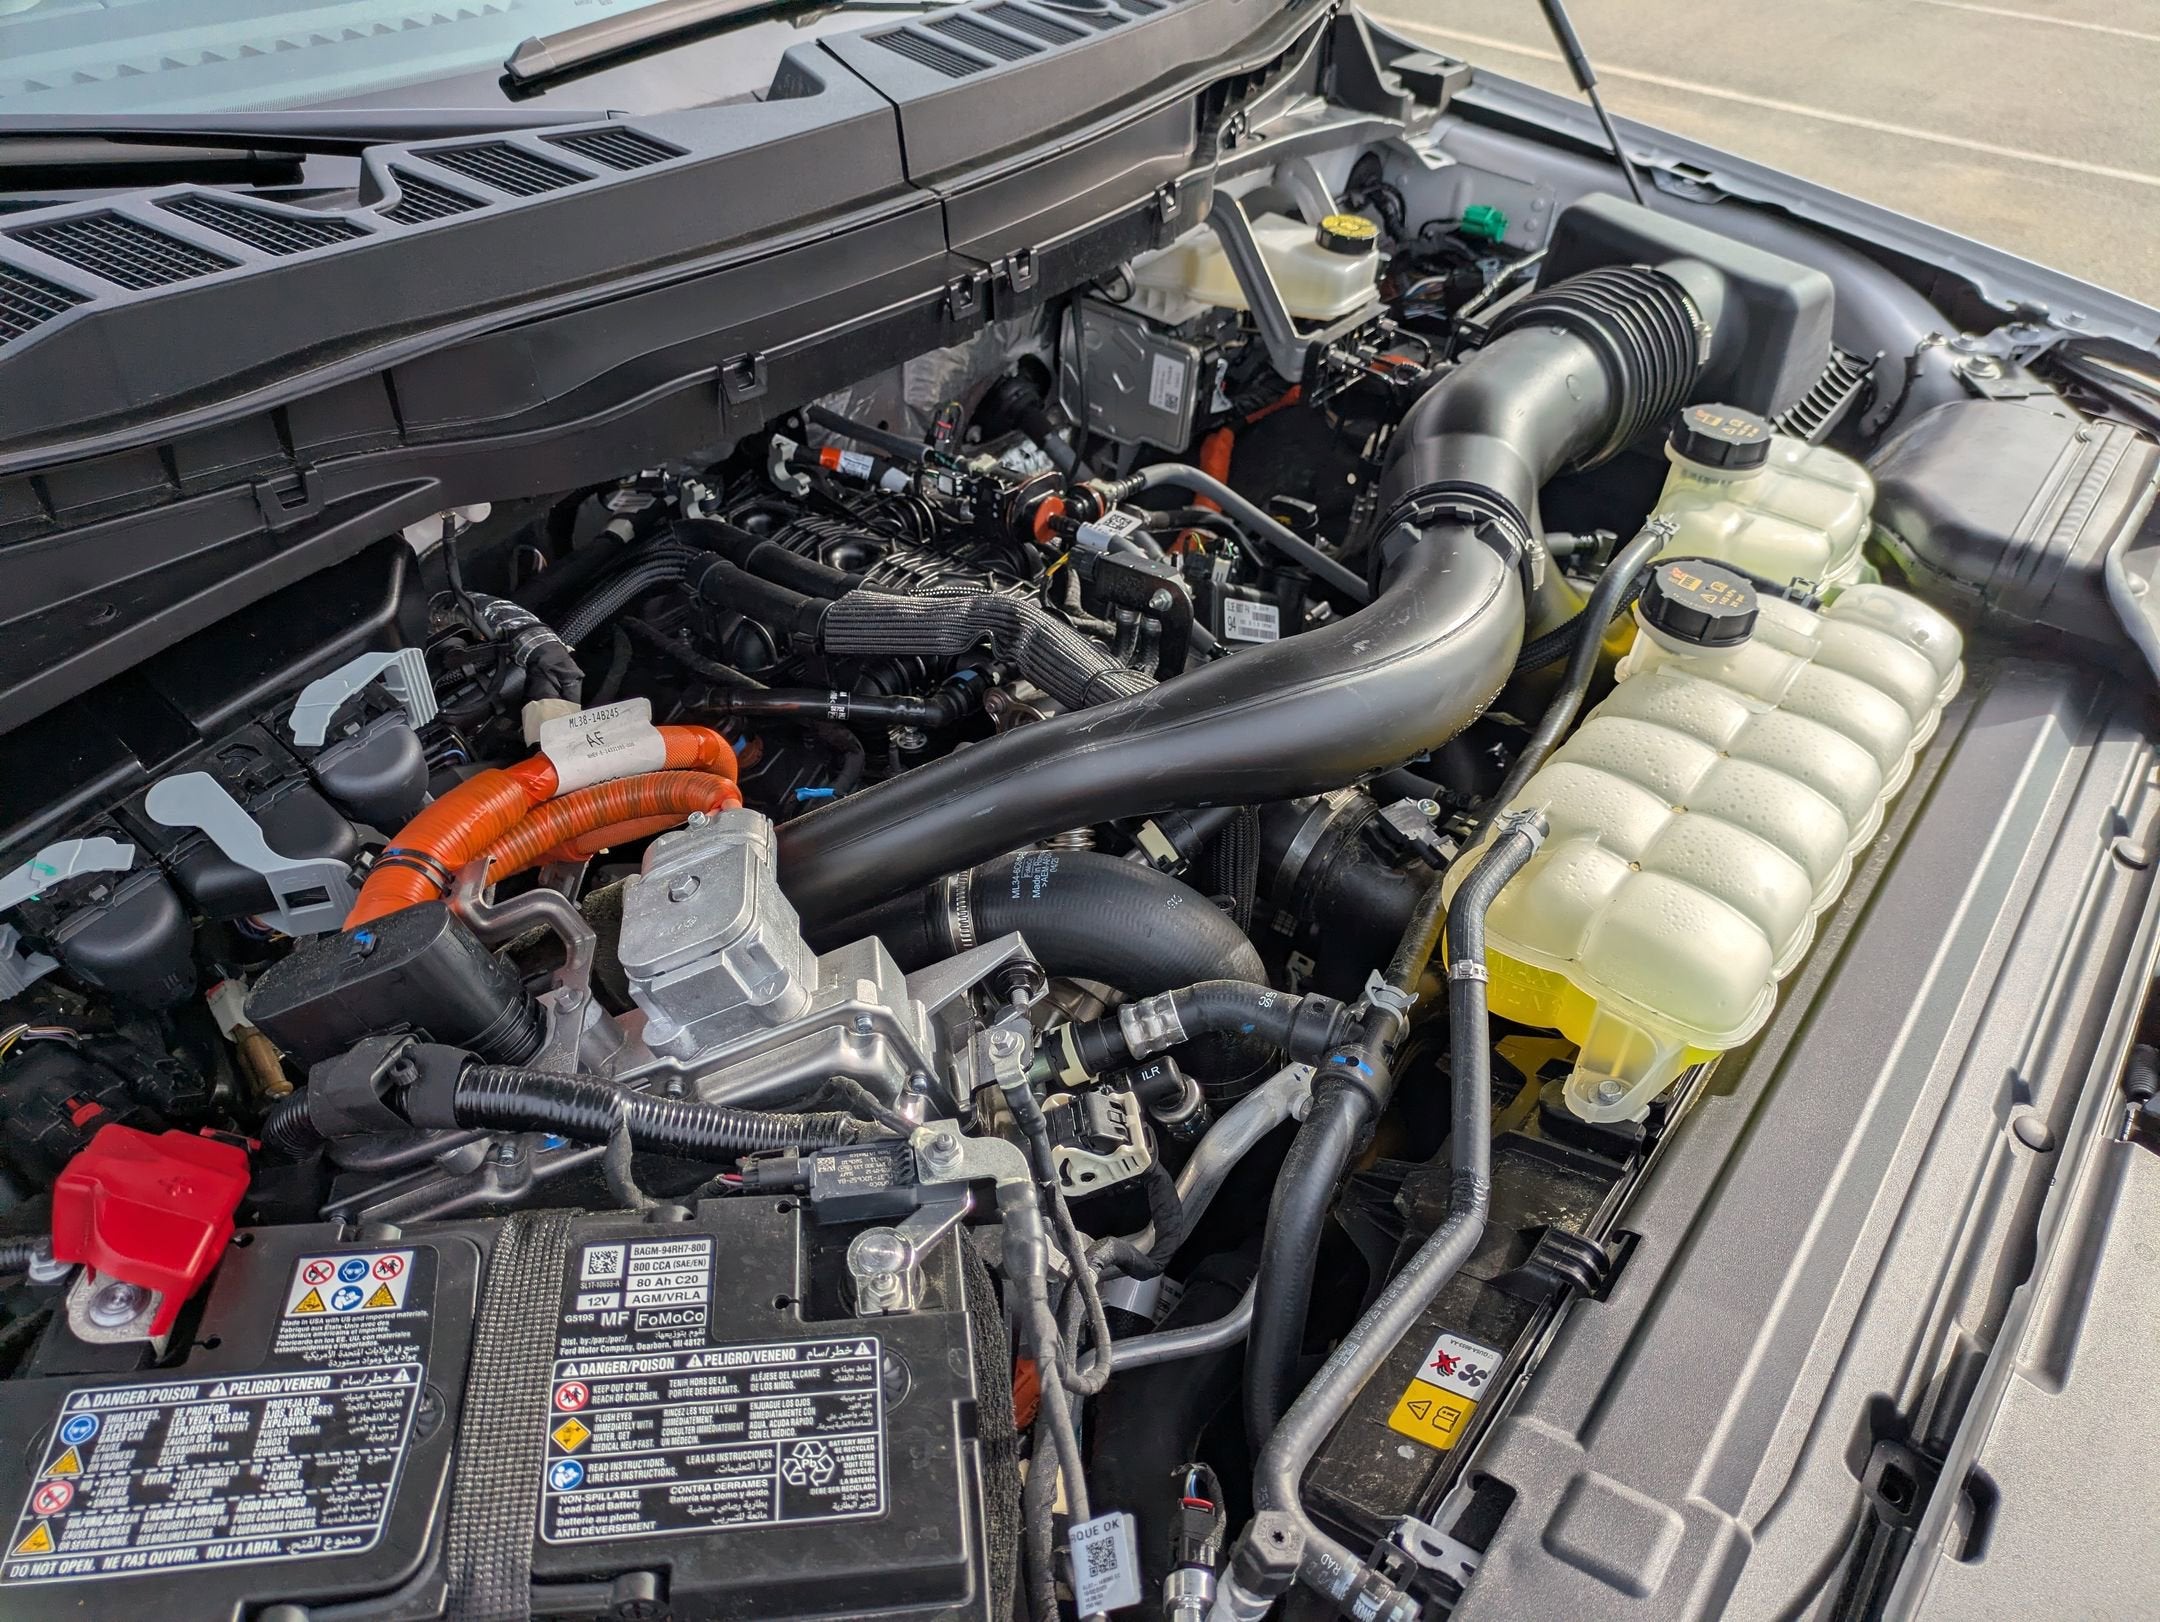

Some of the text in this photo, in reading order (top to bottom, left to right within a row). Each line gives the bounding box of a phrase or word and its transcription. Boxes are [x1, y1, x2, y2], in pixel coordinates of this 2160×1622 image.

[1228, 616, 1236, 631] 94
[569, 708, 619, 728] ML38-14B245
[586, 732, 604, 748] AF
[1258, 996, 1274, 1007] ISC
[1142, 1066, 1160, 1081] ILR
[634, 1243, 706, 1256] BAGM-94RH7-800
[633, 1259, 706, 1271] 800 CCA (SAE/EN)
[636, 1275, 698, 1287] 80 Ah C20
[588, 1296, 610, 1307] 12V
[632, 1291, 700, 1304] AGM/VRLA
[600, 1311, 630, 1327] MF
[639, 1310, 704, 1326] FoMoCo
[560, 1347, 576, 1356] Ford
[578, 1345, 598, 1354] Motor
[684, 1338, 705, 1346] 48121
[561, 1337, 578, 1346] Dist.
[704, 1348, 796, 1366] PELIGRO/VENENO
[806, 1345, 852, 1361] خطر/سام
[580, 1357, 675, 1376] DANGER/POISON
[669, 1376, 727, 1388] TENIR HORS DE LA
[751, 1371, 778, 1382] ALÉJESE
[778, 1371, 790, 1379] DEL
[792, 1369, 820, 1378] ALCANCE
[229, 1376, 331, 1396] PELIGRO/VENENO
[592, 1382, 648, 1393] KEEP OUT OF THE
[750, 1384, 760, 1392] DE
[773, 1380, 796, 1390] NIÑOS.
[92, 1386, 199, 1407] DANGER/POISON
[592, 1395, 614, 1404] REACH
[615, 1394, 625, 1402] OF
[668, 1388, 694, 1399] PORTÉE
[695, 1388, 708, 1396] DES
[266, 1397, 320, 1410] PROTEJA LOS
[288, 1404, 333, 1416] LOS GASES
[171, 1412, 250, 1428] LES LES GAZ
[260, 1416, 312, 1429] EXPLOSIVOS
[595, 1412, 632, 1422] FLUSH EYES
[617, 1431, 630, 1440] GET
[686, 1450, 775, 1464] LEA LAS INSTRUCCIONES.
[271, 1460, 303, 1471] CHISPAS
[588, 1458, 667, 1472] READ INSTRUCTIONS.
[802, 1460, 816, 1468] Pb
[269, 1471, 299, 1481] FLAMAS
[587, 1467, 678, 1483] LIRE LES INSTRUCTIONS.
[266, 1479, 304, 1491] CIGARROS
[670, 1479, 768, 1495] CONTRA DERRAMES
[559, 1490, 639, 1504] NON-SPILLABLE
[701, 1493, 711, 1501] de
[712, 1492, 738, 1500] plomo
[746, 1489, 769, 1497] ácido
[558, 1500, 641, 1514] Lead Acid Battery
[556, 1517, 594, 1526] Batterie
[610, 1513, 639, 1524] plomb
[1104, 1519, 1120, 1532] OK
[555, 1520, 656, 1538] ANTI DÉVERSEMENT
[10, 1540, 281, 1578] DO NOT OPEN. NE PAS OUVRIR. NO LA ABRA.
[1321, 1553, 1342, 1576] RAD
